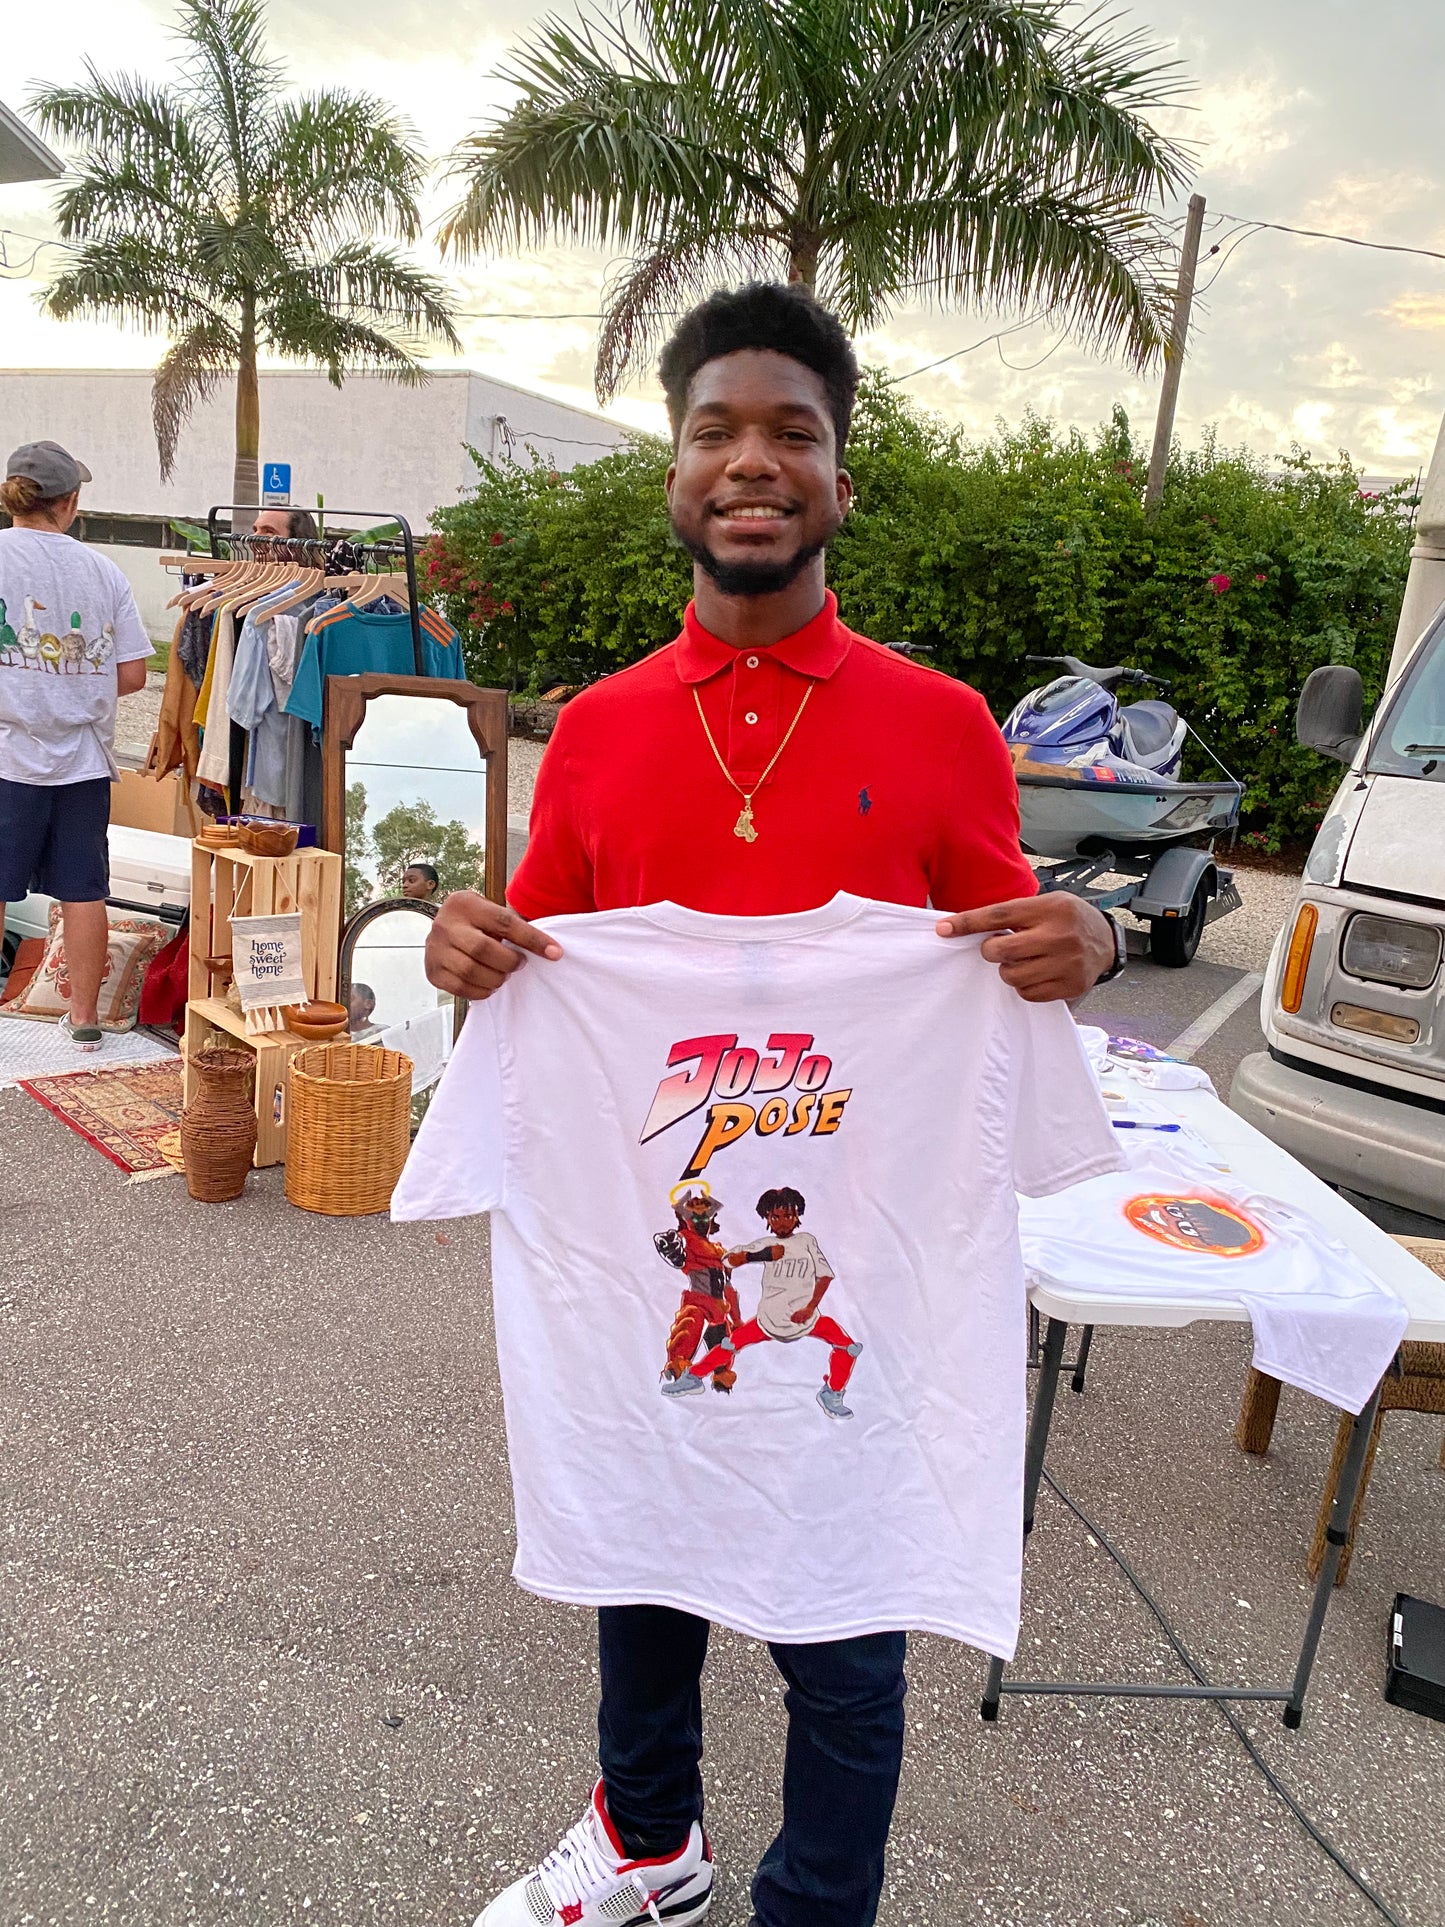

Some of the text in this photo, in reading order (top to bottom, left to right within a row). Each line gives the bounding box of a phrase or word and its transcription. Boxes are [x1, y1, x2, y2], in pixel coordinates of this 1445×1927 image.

[251, 940, 284, 955] home
[249, 952, 287, 965] sweet
[251, 965, 284, 979] home
[679, 1088, 853, 1181] POSE
[773, 1258, 809, 1278] 777
